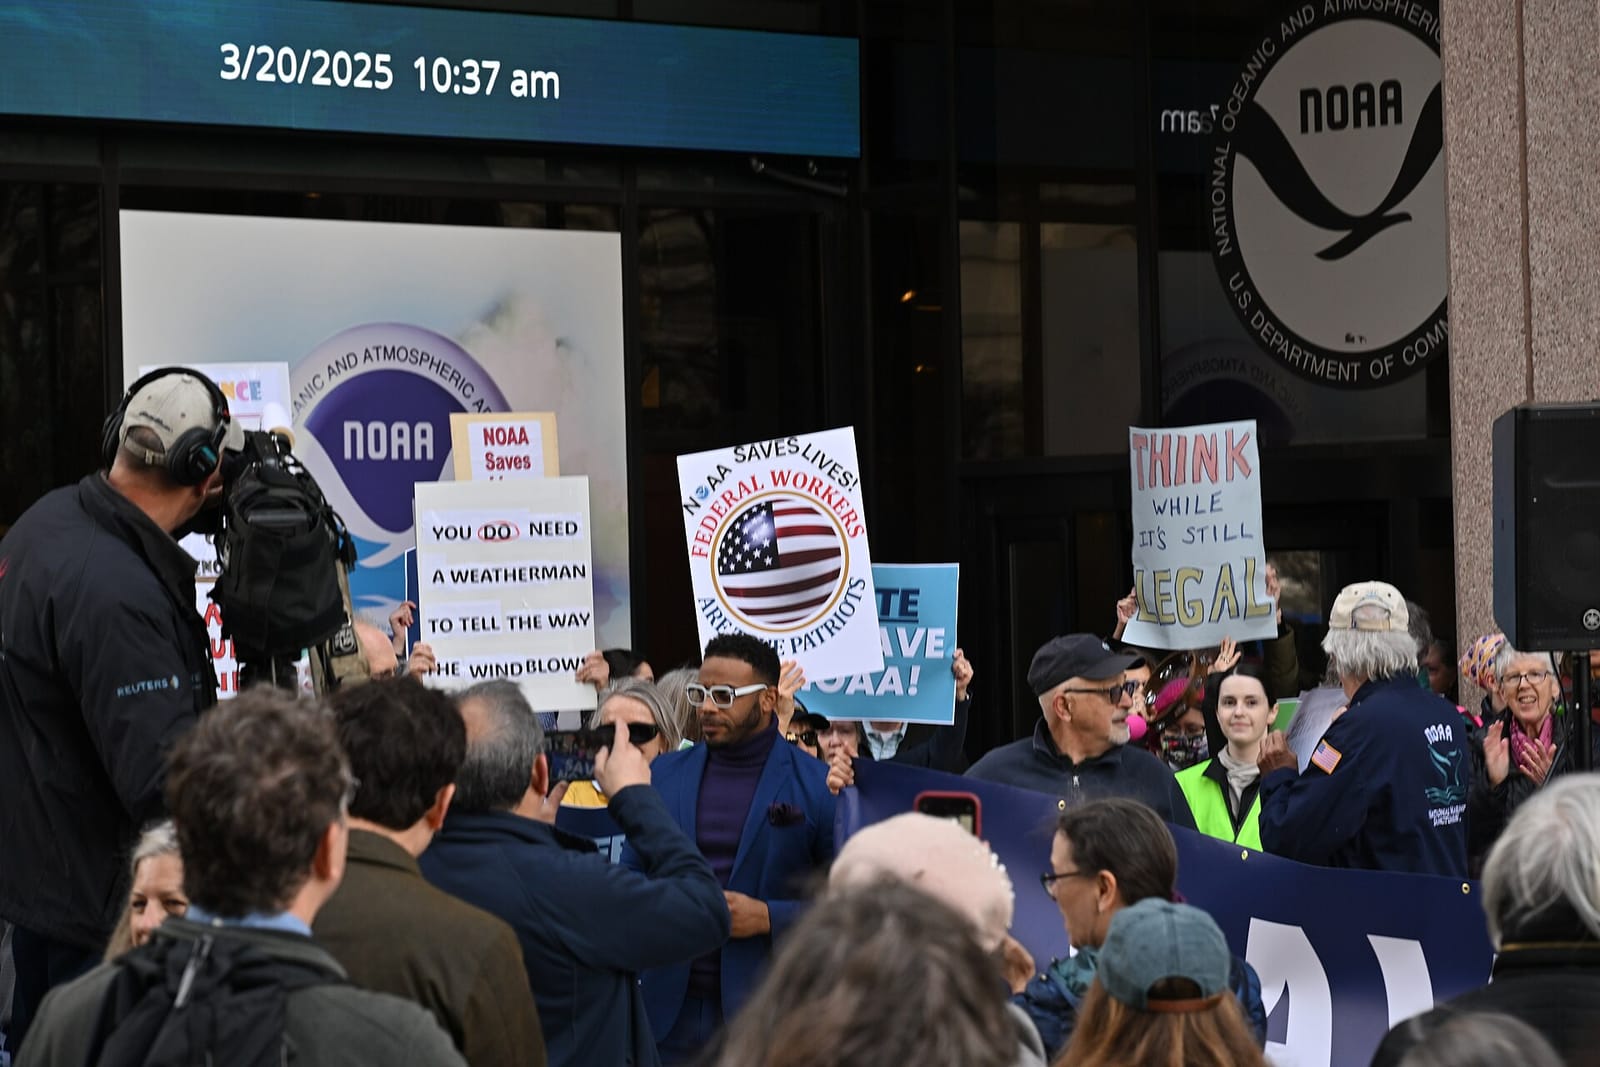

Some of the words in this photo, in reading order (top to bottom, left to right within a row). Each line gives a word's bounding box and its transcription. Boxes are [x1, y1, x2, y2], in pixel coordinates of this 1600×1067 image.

[220, 43, 393, 90] 3/20/2025
[414, 56, 500, 96] 10:37
[510, 69, 560, 99] am
[1300, 79, 1403, 134] NOAA
[1211, 141, 1232, 256] NATIONAL
[1222, 37, 1276, 132] OCEANIC
[1280, 5, 1315, 41] AND
[1229, 271, 1251, 315] U.S.
[1250, 310, 1361, 382] DEPARTMENT
[1369, 354, 1395, 380] OF
[327, 351, 358, 382] AND
[363, 345, 475, 399] ATMOSPHERIC
[344, 421, 434, 460] NOAA
[483, 426, 529, 447] NOAA
[1132, 428, 1252, 491] THINK
[485, 452, 531, 471] Saves
[733, 436, 800, 463] SAVES
[801, 443, 858, 493] LIVES!
[692, 474, 764, 558] FEDERAL
[770, 469, 864, 539] WORKERS
[1153, 491, 1223, 517] WHILE
[432, 525, 472, 541] YOU
[484, 523, 511, 540] DO
[529, 520, 578, 537] NEED
[1139, 526, 1167, 550] IT'S
[1182, 522, 1253, 545] STILL
[432, 569, 445, 584] A
[450, 564, 586, 584] WEATHERMAN
[1136, 556, 1272, 628] LEGAL
[428, 618, 453, 634] TO
[459, 616, 500, 632] TELL
[506, 614, 543, 631] THE
[548, 612, 591, 629] WAY
[789, 576, 866, 654] PATRIOTS
[428, 662, 461, 677] HE
[470, 661, 523, 678] WIND
[1424, 724, 1453, 744] NOAA
